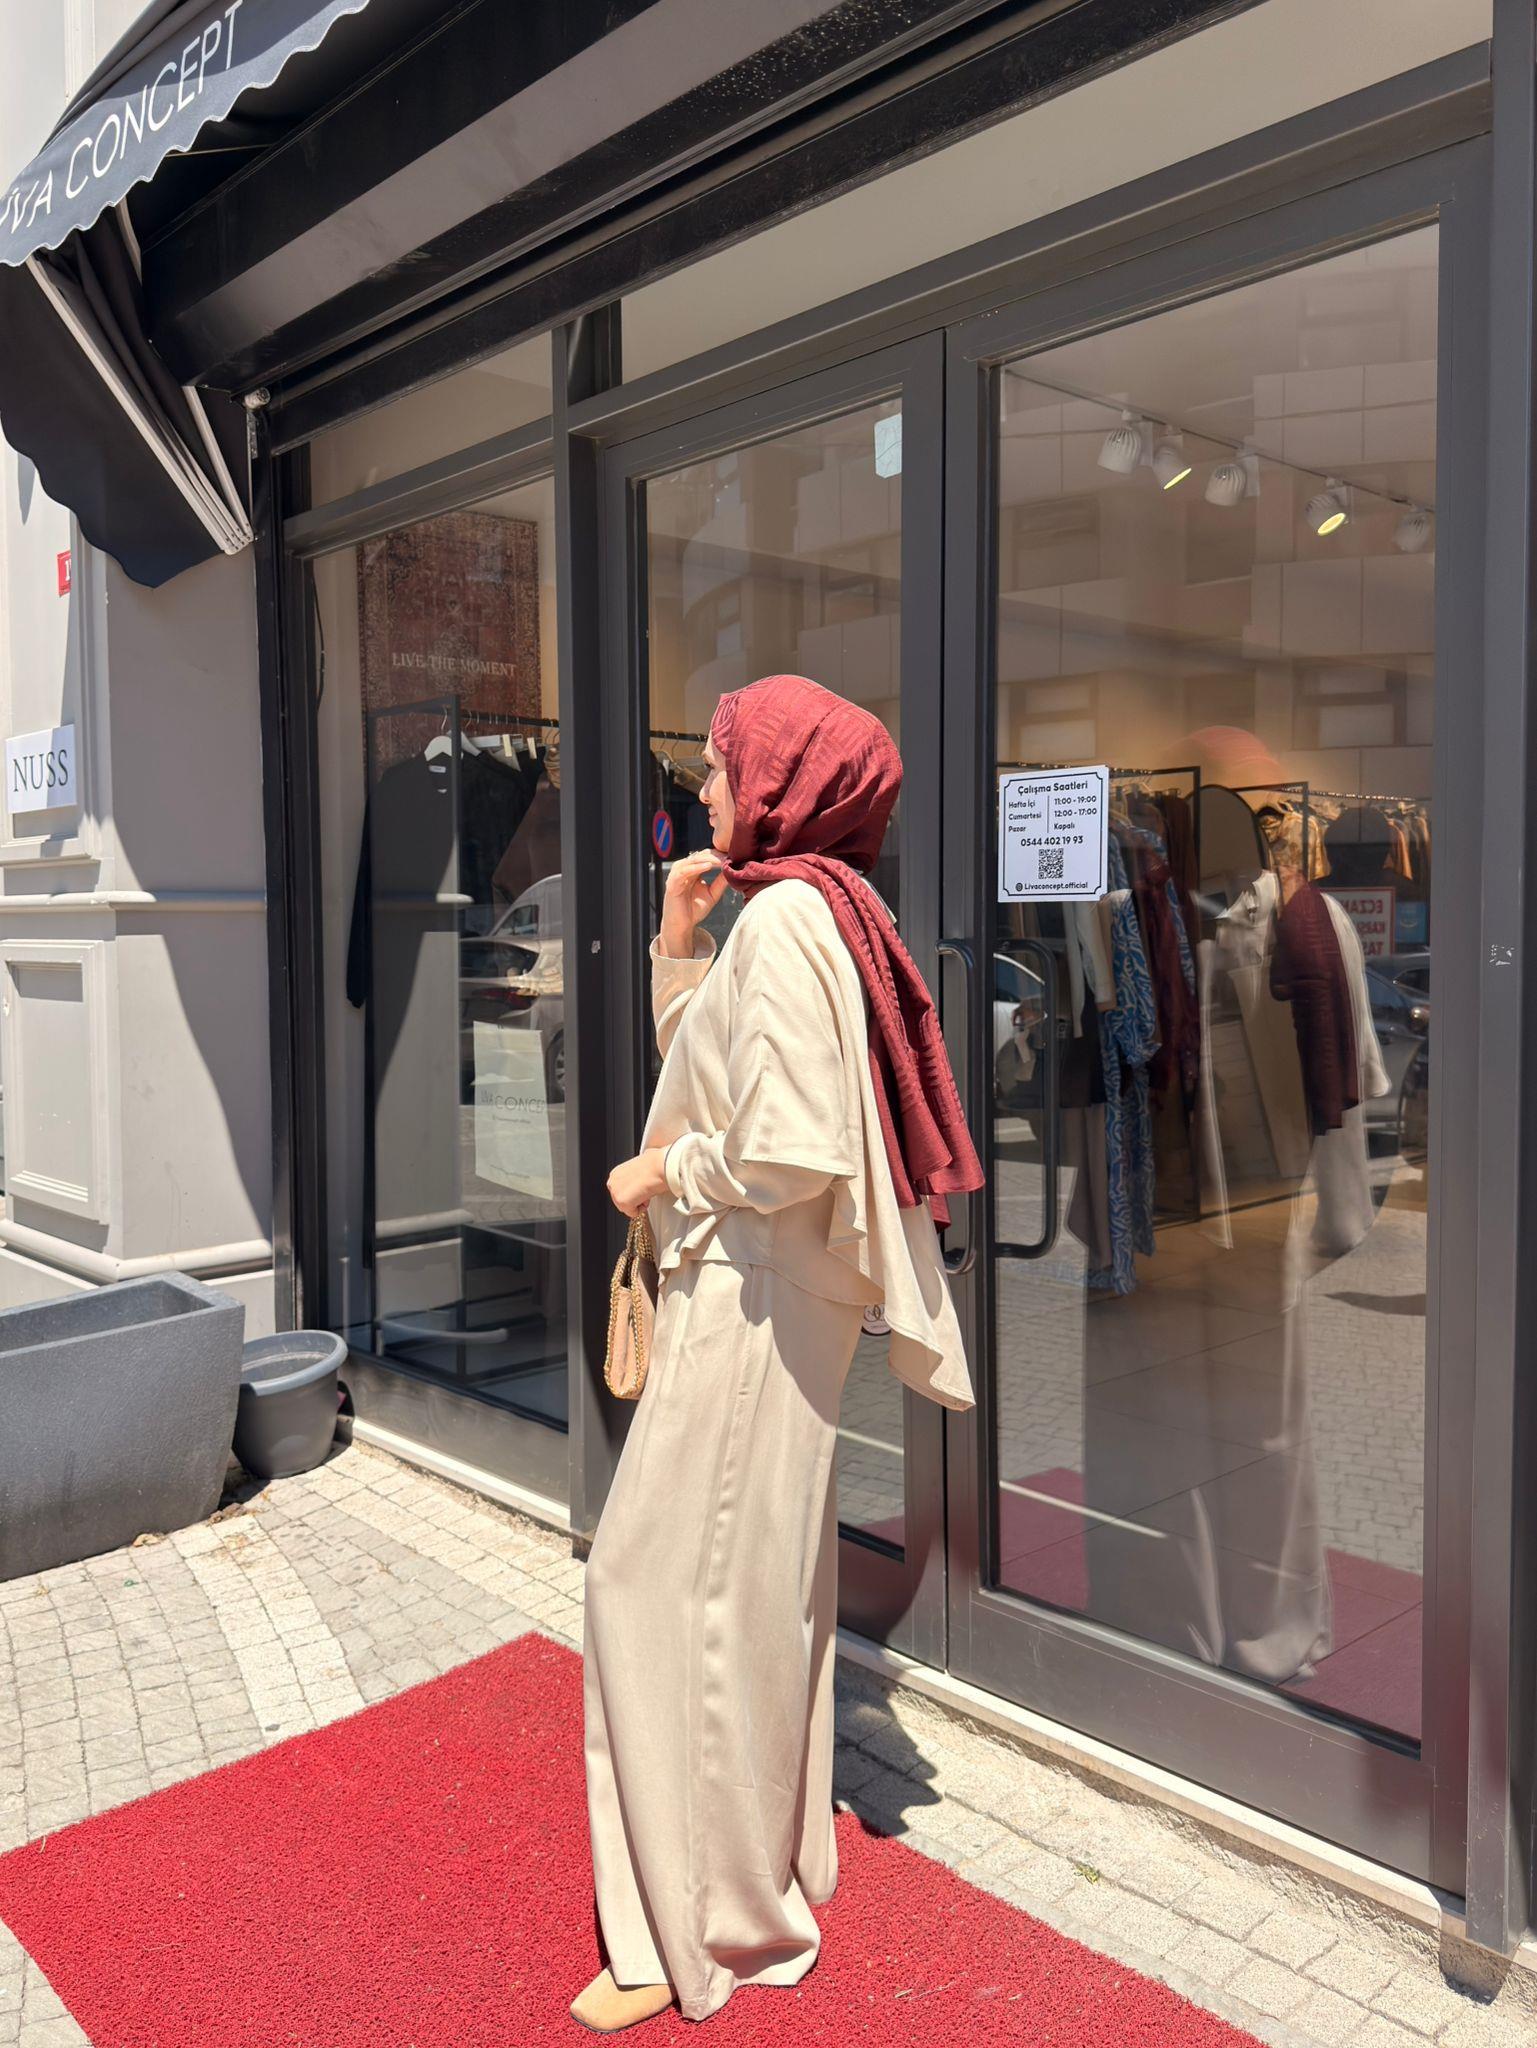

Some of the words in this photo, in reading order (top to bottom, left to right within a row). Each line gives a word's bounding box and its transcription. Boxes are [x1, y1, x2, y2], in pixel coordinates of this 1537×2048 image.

[65, 0, 243, 199] CONCEPT
[392, 652, 425, 668] LIVE
[428, 655, 457, 671] THE
[460, 659, 517, 677] MOMENT
[13, 749, 68, 792] NUSS
[1017, 785, 1051, 796] Çalışma
[1053, 781, 1088, 791] Saatleri
[1008, 801, 1026, 809] Hafta
[1054, 797, 1072, 805] 11:00
[1077, 795, 1097, 804] 19:00
[1008, 812, 1042, 820] Cumartesi
[1054, 810, 1073, 818] 12:00
[1078, 808, 1097, 816] 17:00
[1054, 822, 1075, 831] Kapalı
[1020, 837, 1042, 846] 0544
[1044, 836, 1060, 845] 402
[1062, 836, 1071, 844] 19
[1072, 835, 1084, 844] 93
